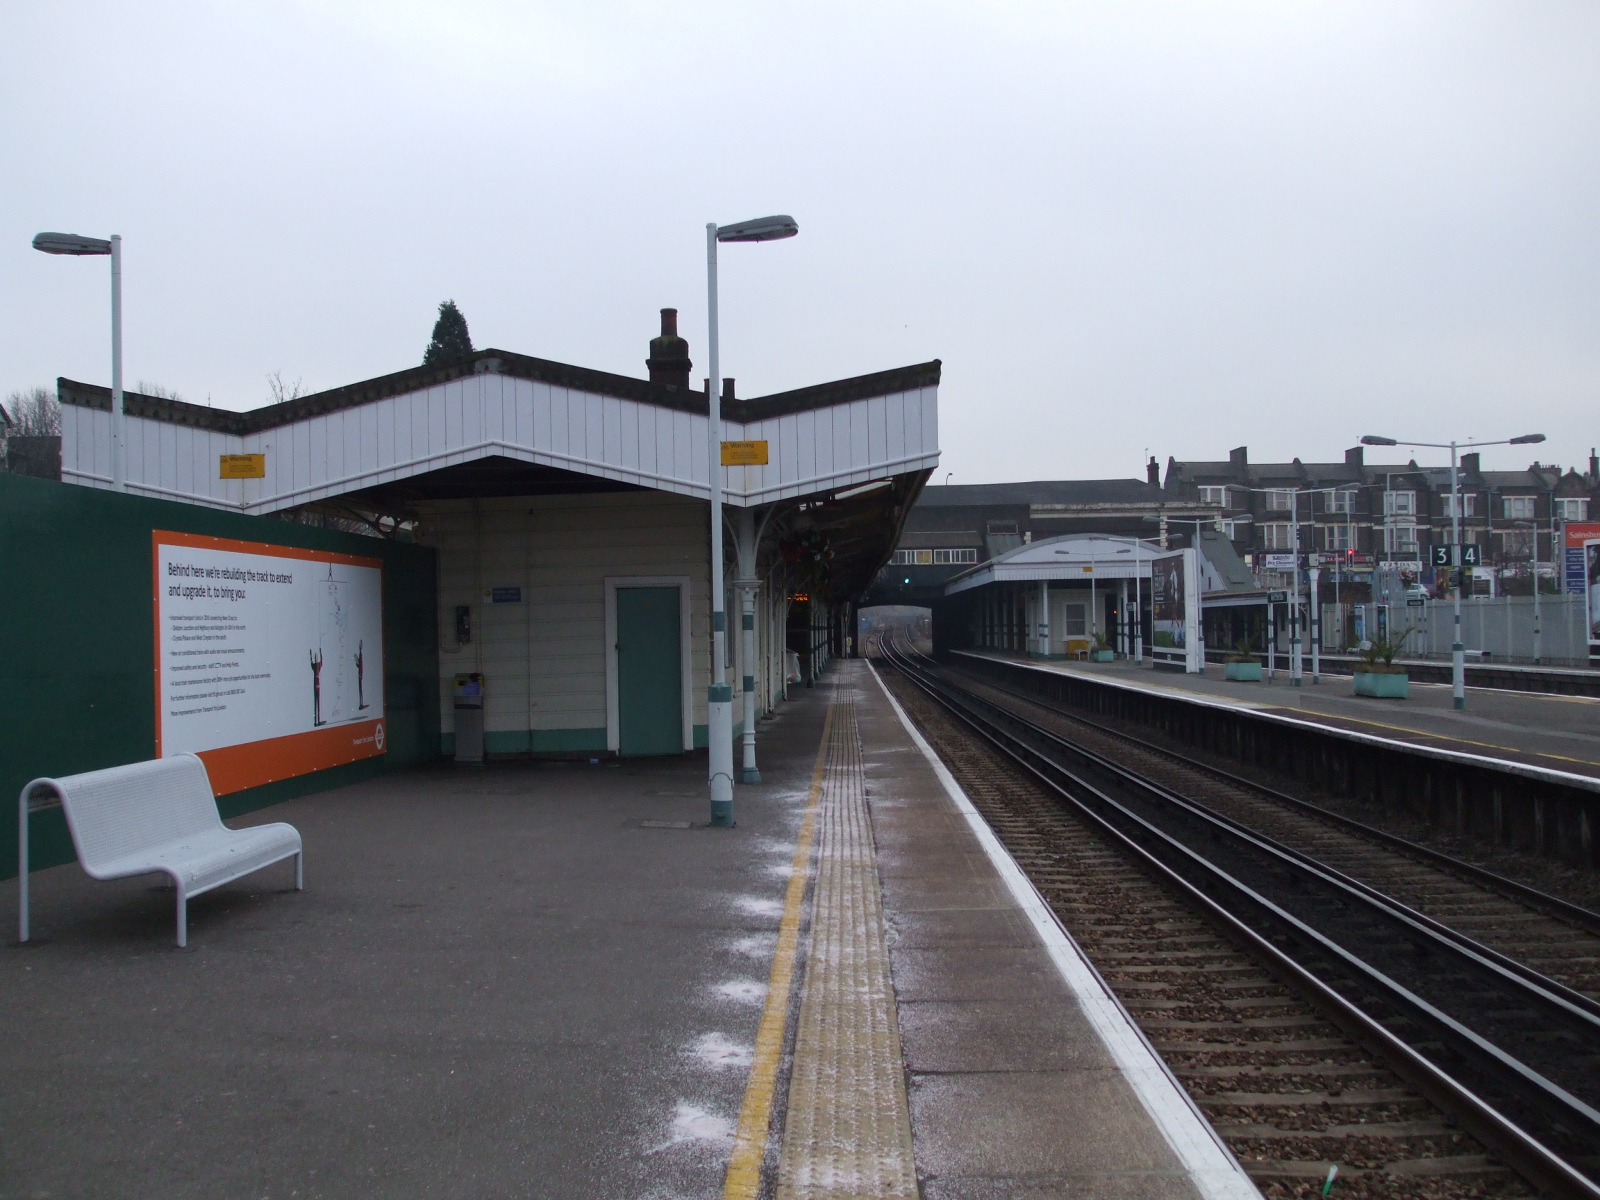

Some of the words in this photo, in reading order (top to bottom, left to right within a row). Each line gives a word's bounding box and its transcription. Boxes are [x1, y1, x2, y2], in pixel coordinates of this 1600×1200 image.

[1437, 547, 1448, 564] 3
[1464, 547, 1476, 563] 4
[168, 562, 190, 577] Behind
[191, 564, 204, 578] here
[205, 566, 220, 579] we're
[221, 567, 246, 584] rebuilding
[247, 569, 256, 582] the
[256, 570, 269, 582] track
[270, 571, 276, 583] to
[276, 572, 292, 584] extend
[169, 583, 181, 597] and
[182, 584, 206, 600] upgrade
[214, 587, 220, 598] to
[221, 586, 234, 602] bring
